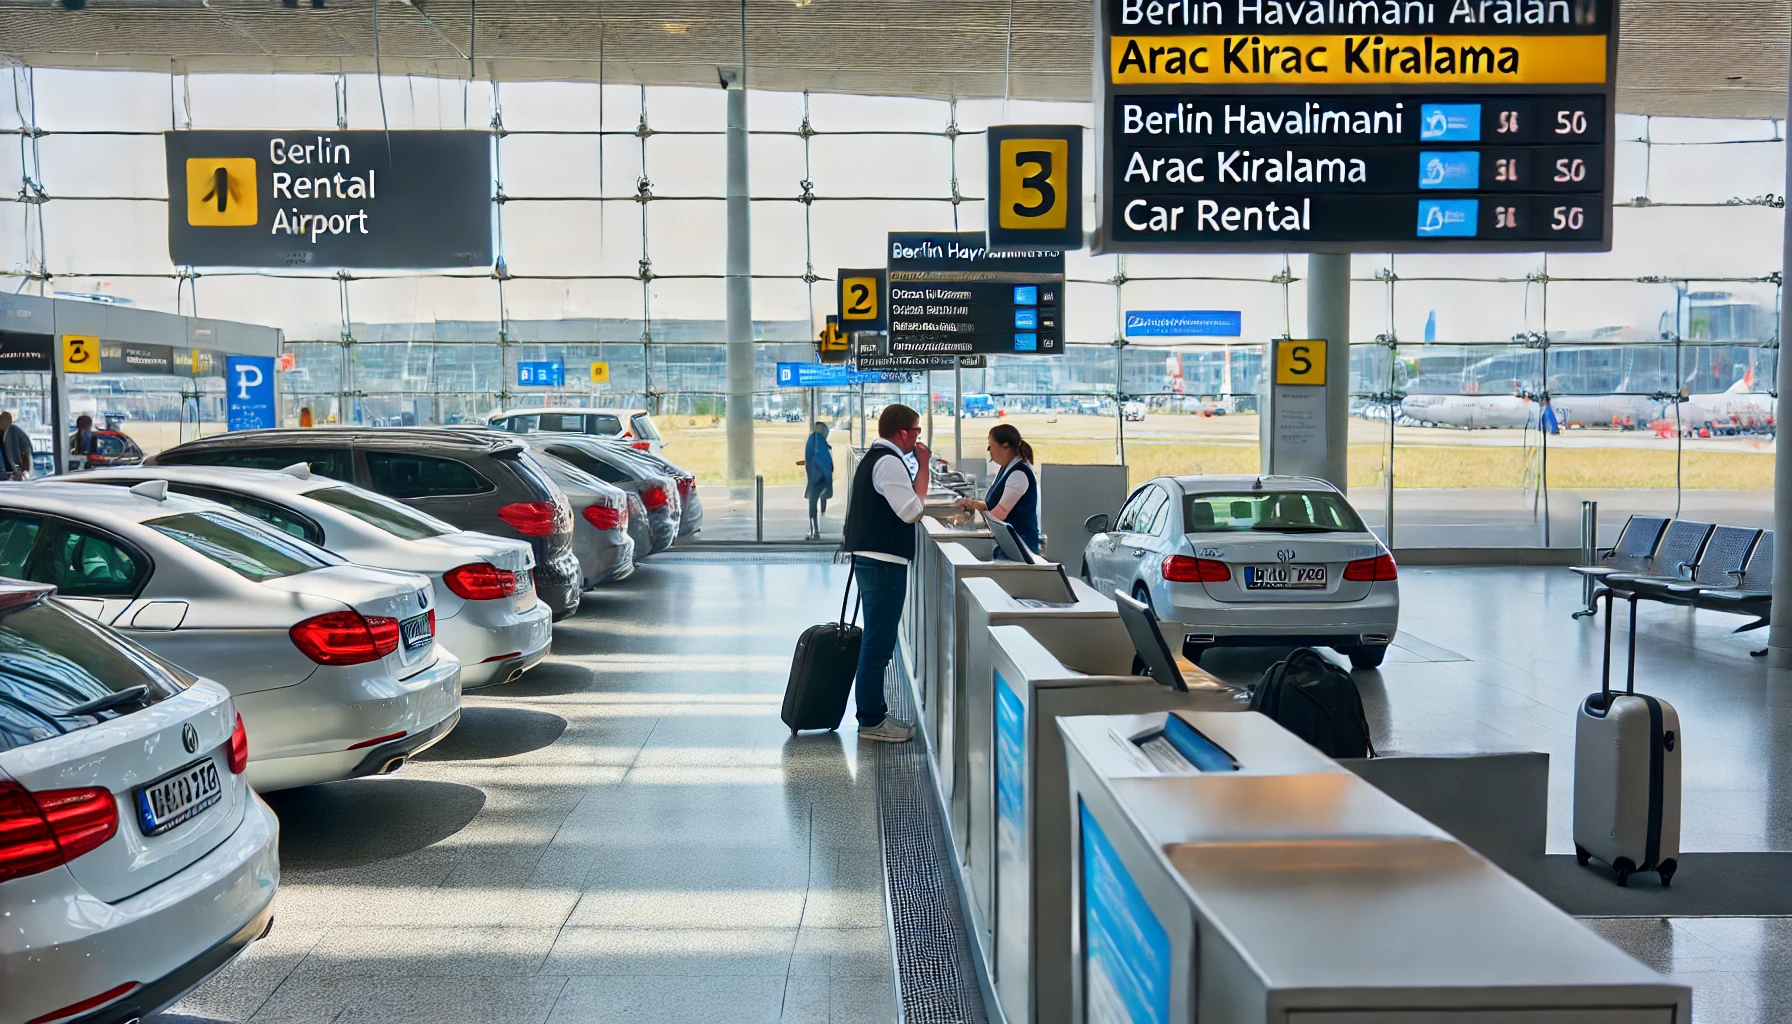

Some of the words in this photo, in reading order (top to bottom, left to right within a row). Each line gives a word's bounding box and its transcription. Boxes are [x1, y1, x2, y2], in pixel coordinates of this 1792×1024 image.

[1118, 39, 1209, 75] Arac
[1223, 36, 1328, 73] Kirac
[1344, 35, 1519, 75] Kiralama
[1123, 102, 1213, 135] Berlin
[1224, 101, 1404, 135] Havalimani
[1123, 151, 1205, 183] Arac
[1217, 150, 1367, 183] Kiralama
[272, 169, 375, 199] Rental
[1012, 150, 1056, 218] 3
[271, 207, 369, 244] Airport
[1123, 199, 1184, 232] Car
[1197, 198, 1311, 231] Rental
[847, 283, 873, 314] 2
[234, 364, 263, 399] P
